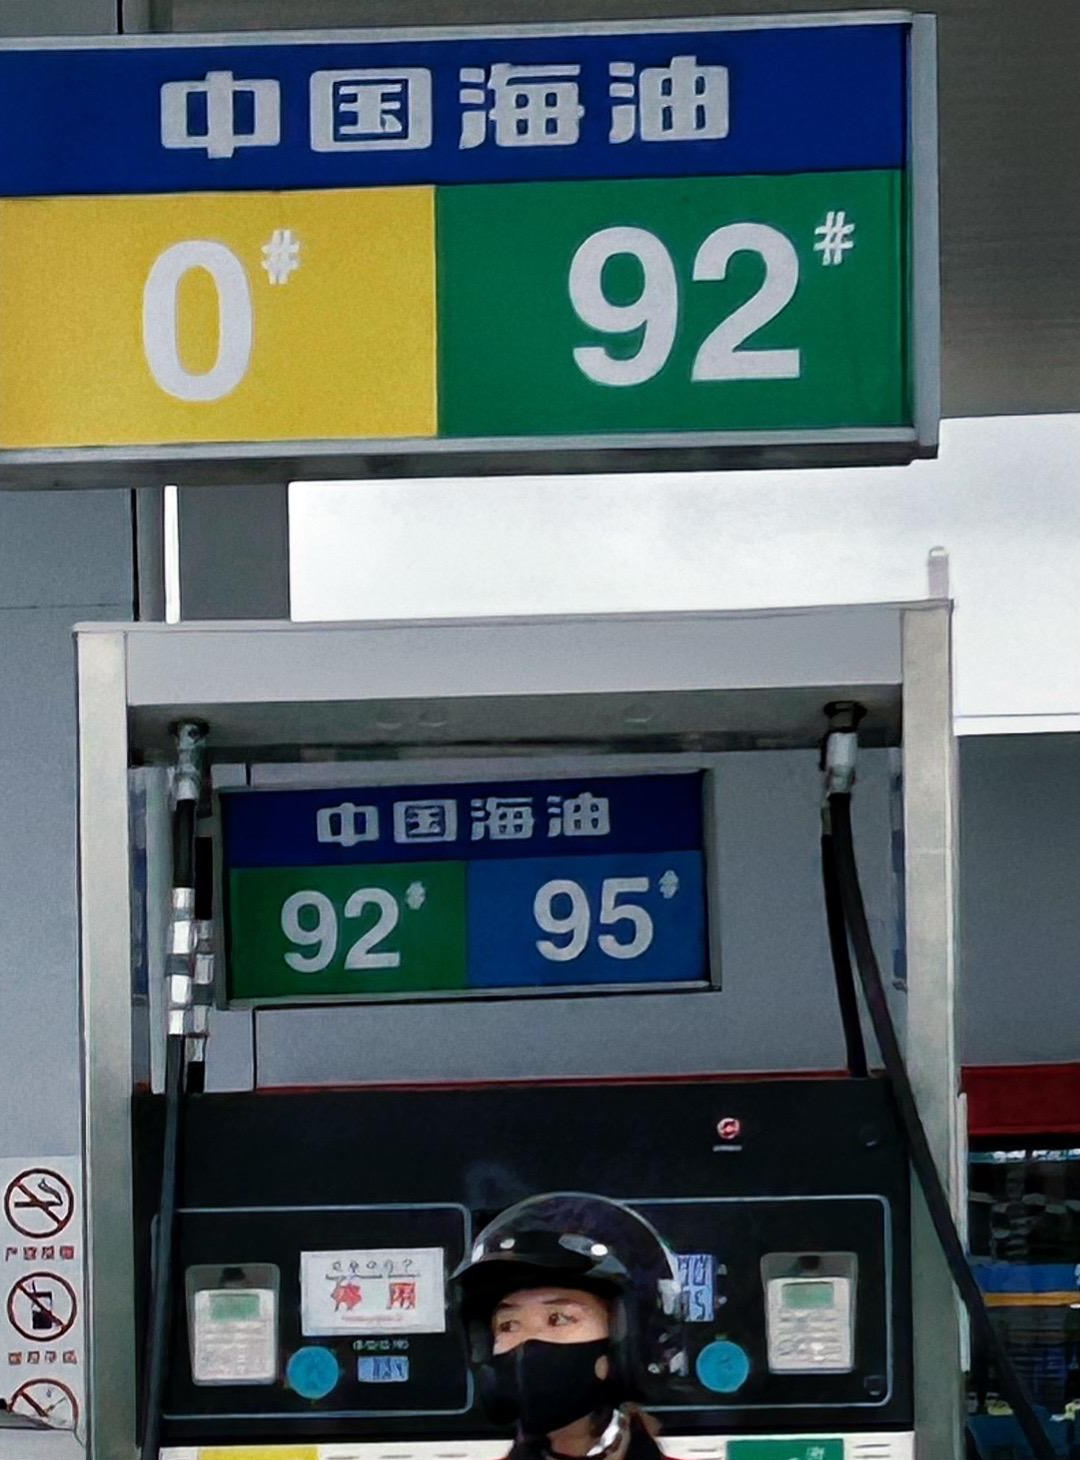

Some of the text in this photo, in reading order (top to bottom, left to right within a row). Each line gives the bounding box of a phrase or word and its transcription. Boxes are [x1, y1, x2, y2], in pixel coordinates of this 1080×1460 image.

[160, 56, 730, 159] 中国海油
[141, 229, 301, 402] 0#
[568, 210, 855, 387] 92#
[315, 791, 612, 847] 中国海油
